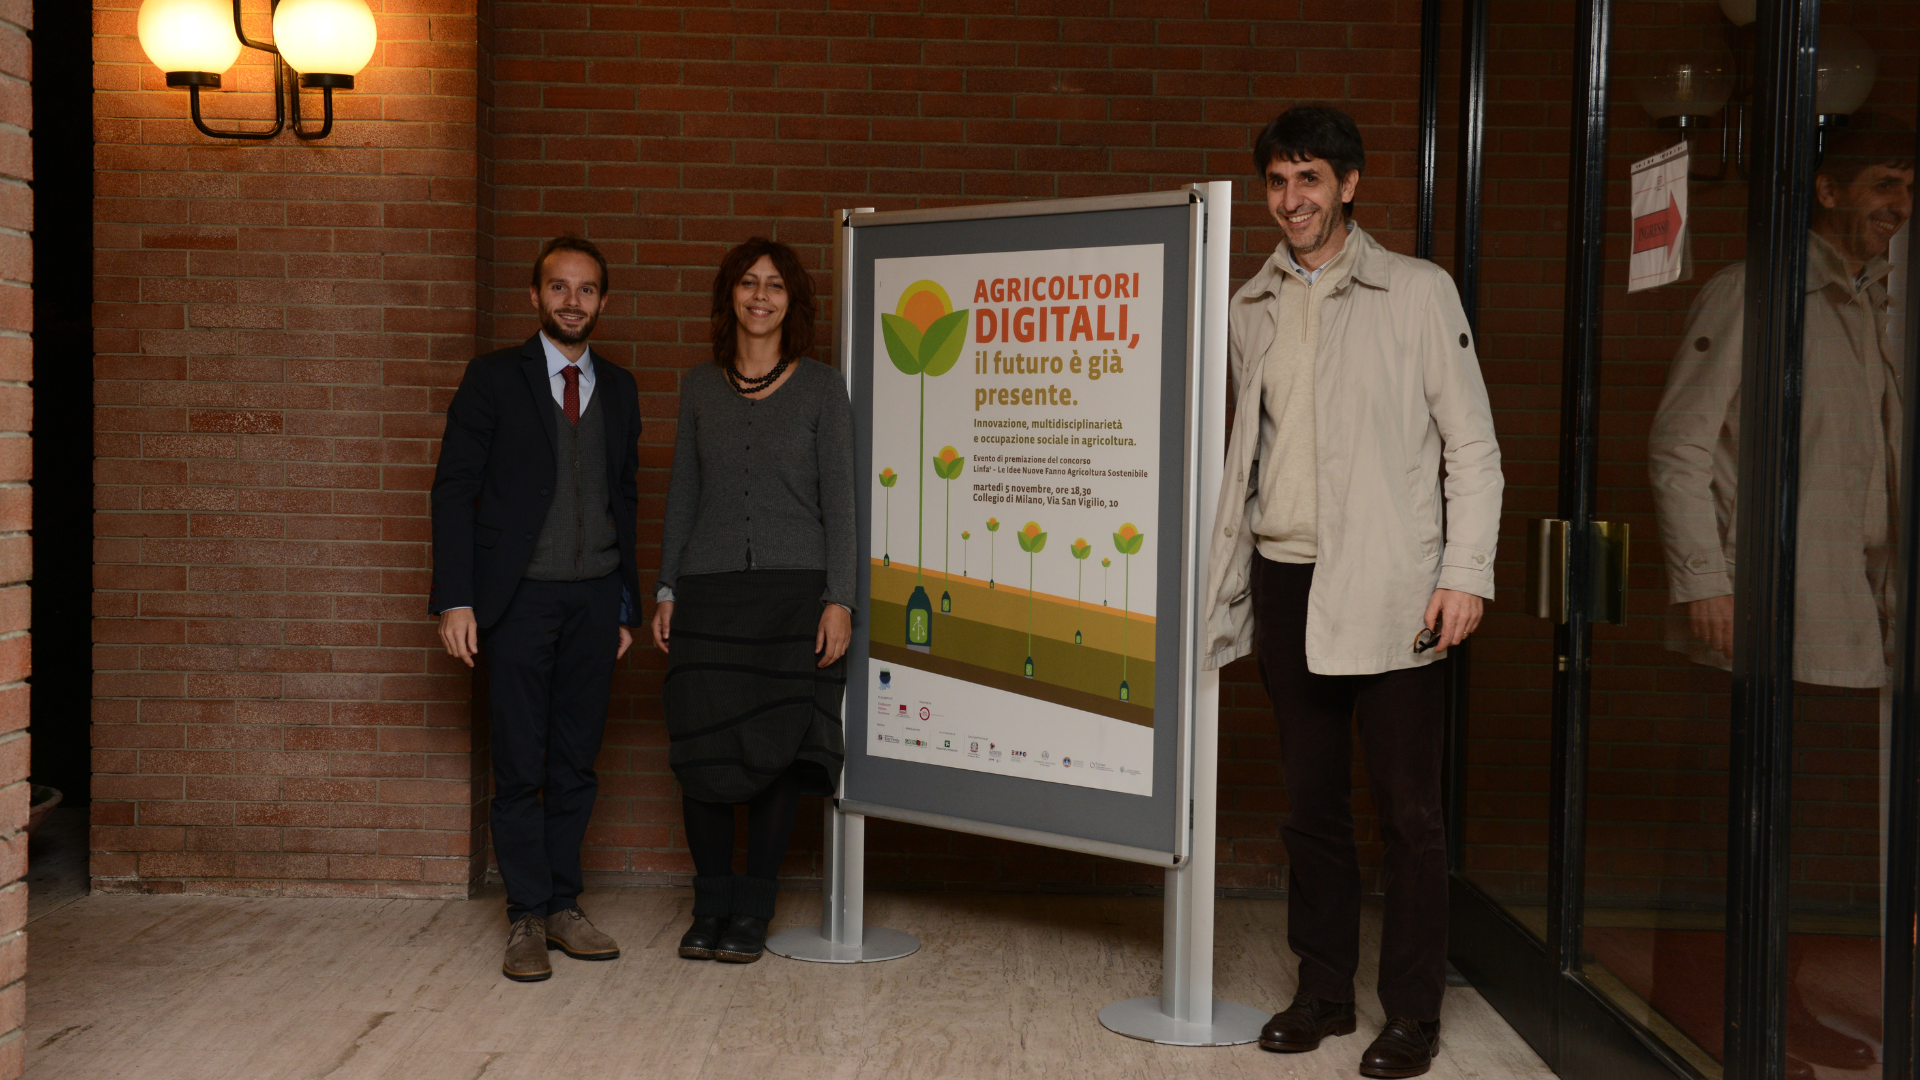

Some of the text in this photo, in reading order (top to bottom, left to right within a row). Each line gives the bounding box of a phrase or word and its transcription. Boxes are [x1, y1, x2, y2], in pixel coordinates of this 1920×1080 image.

[1638, 220, 1669, 241] INGRESSO
[973, 272, 1139, 303] AGRICOLTORI
[975, 304, 1140, 349] DIGITALI,
[975, 348, 1123, 380] il futuro è già
[975, 384, 1078, 411] presente.
[973, 418, 1123, 431] Innovazione, multidisciplinarietà
[981, 434, 1035, 446] occupazione
[1037, 434, 1068, 445] sociale
[1071, 435, 1079, 445] in
[1082, 435, 1137, 447] agricoltura.
[1004, 455, 1046, 465] premiazione
[1047, 456, 1058, 464] del
[1059, 457, 1091, 465] concorso
[1007, 466, 1021, 474] Idee
[1022, 467, 1044, 475] Nuove
[1067, 468, 1106, 478] Agricoltura
[1108, 469, 1148, 478] Sostenibile
[1005, 485, 1010, 493] 5
[1011, 484, 1053, 495] novembre,
[1071, 486, 1091, 496] 18,30
[973, 493, 1005, 504] Collegio
[1006, 494, 1014, 503] di
[1015, 495, 1045, 506] Milano,
[1047, 496, 1060, 505] Via
[1061, 497, 1077, 506] San
[1078, 497, 1107, 509] Vigilio,
